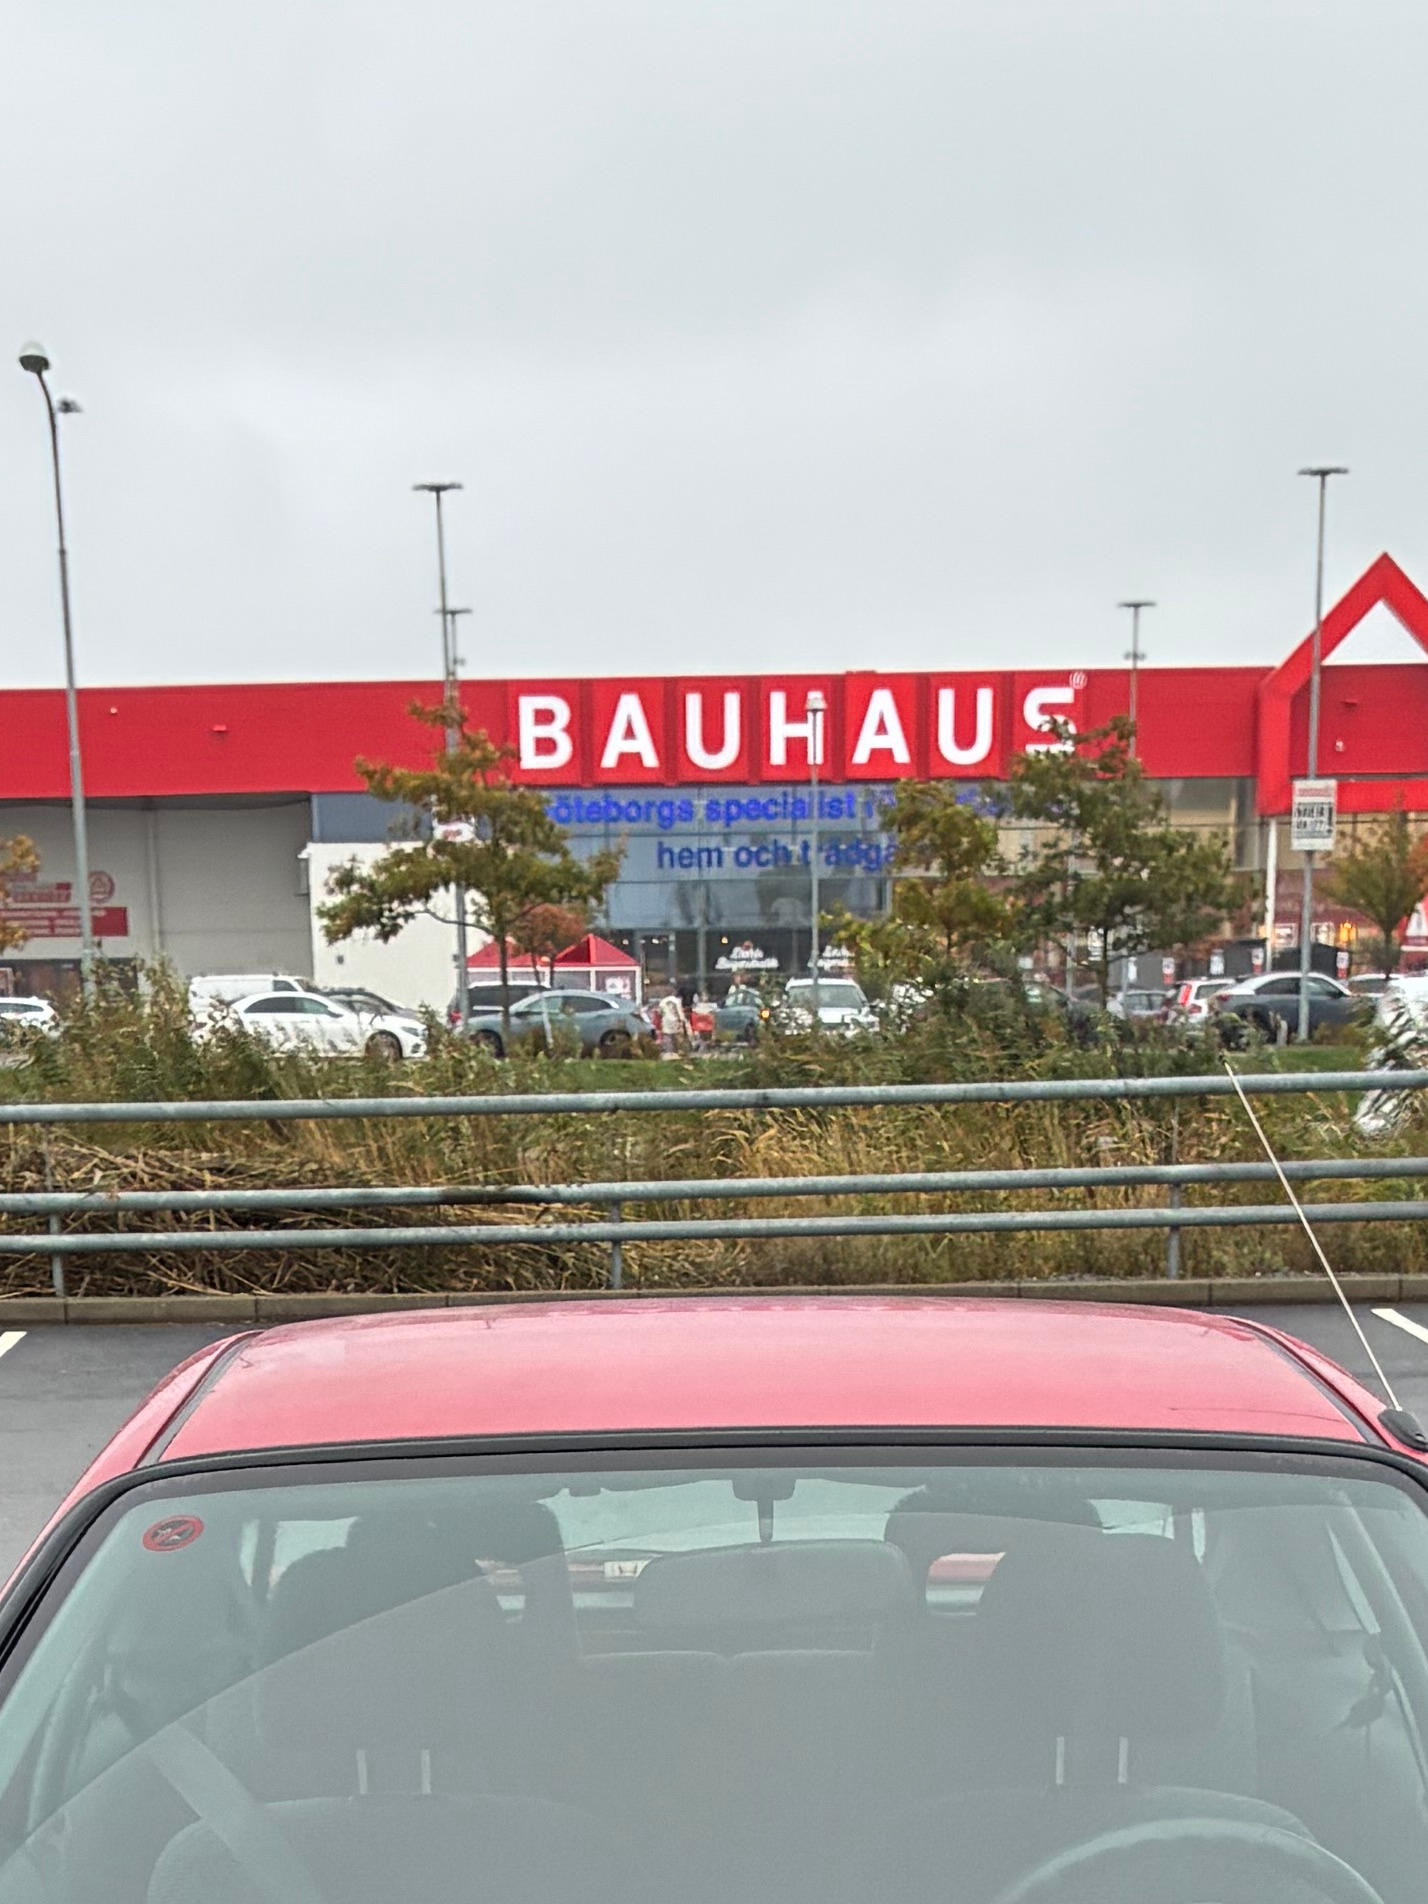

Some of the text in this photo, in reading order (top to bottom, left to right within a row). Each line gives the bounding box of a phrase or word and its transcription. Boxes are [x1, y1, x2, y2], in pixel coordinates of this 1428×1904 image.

[518, 686, 1077, 769] BAUHAUS
[545, 792, 693, 829] öteborgs
[657, 841, 723, 869] hem
[733, 839, 792, 867] och
